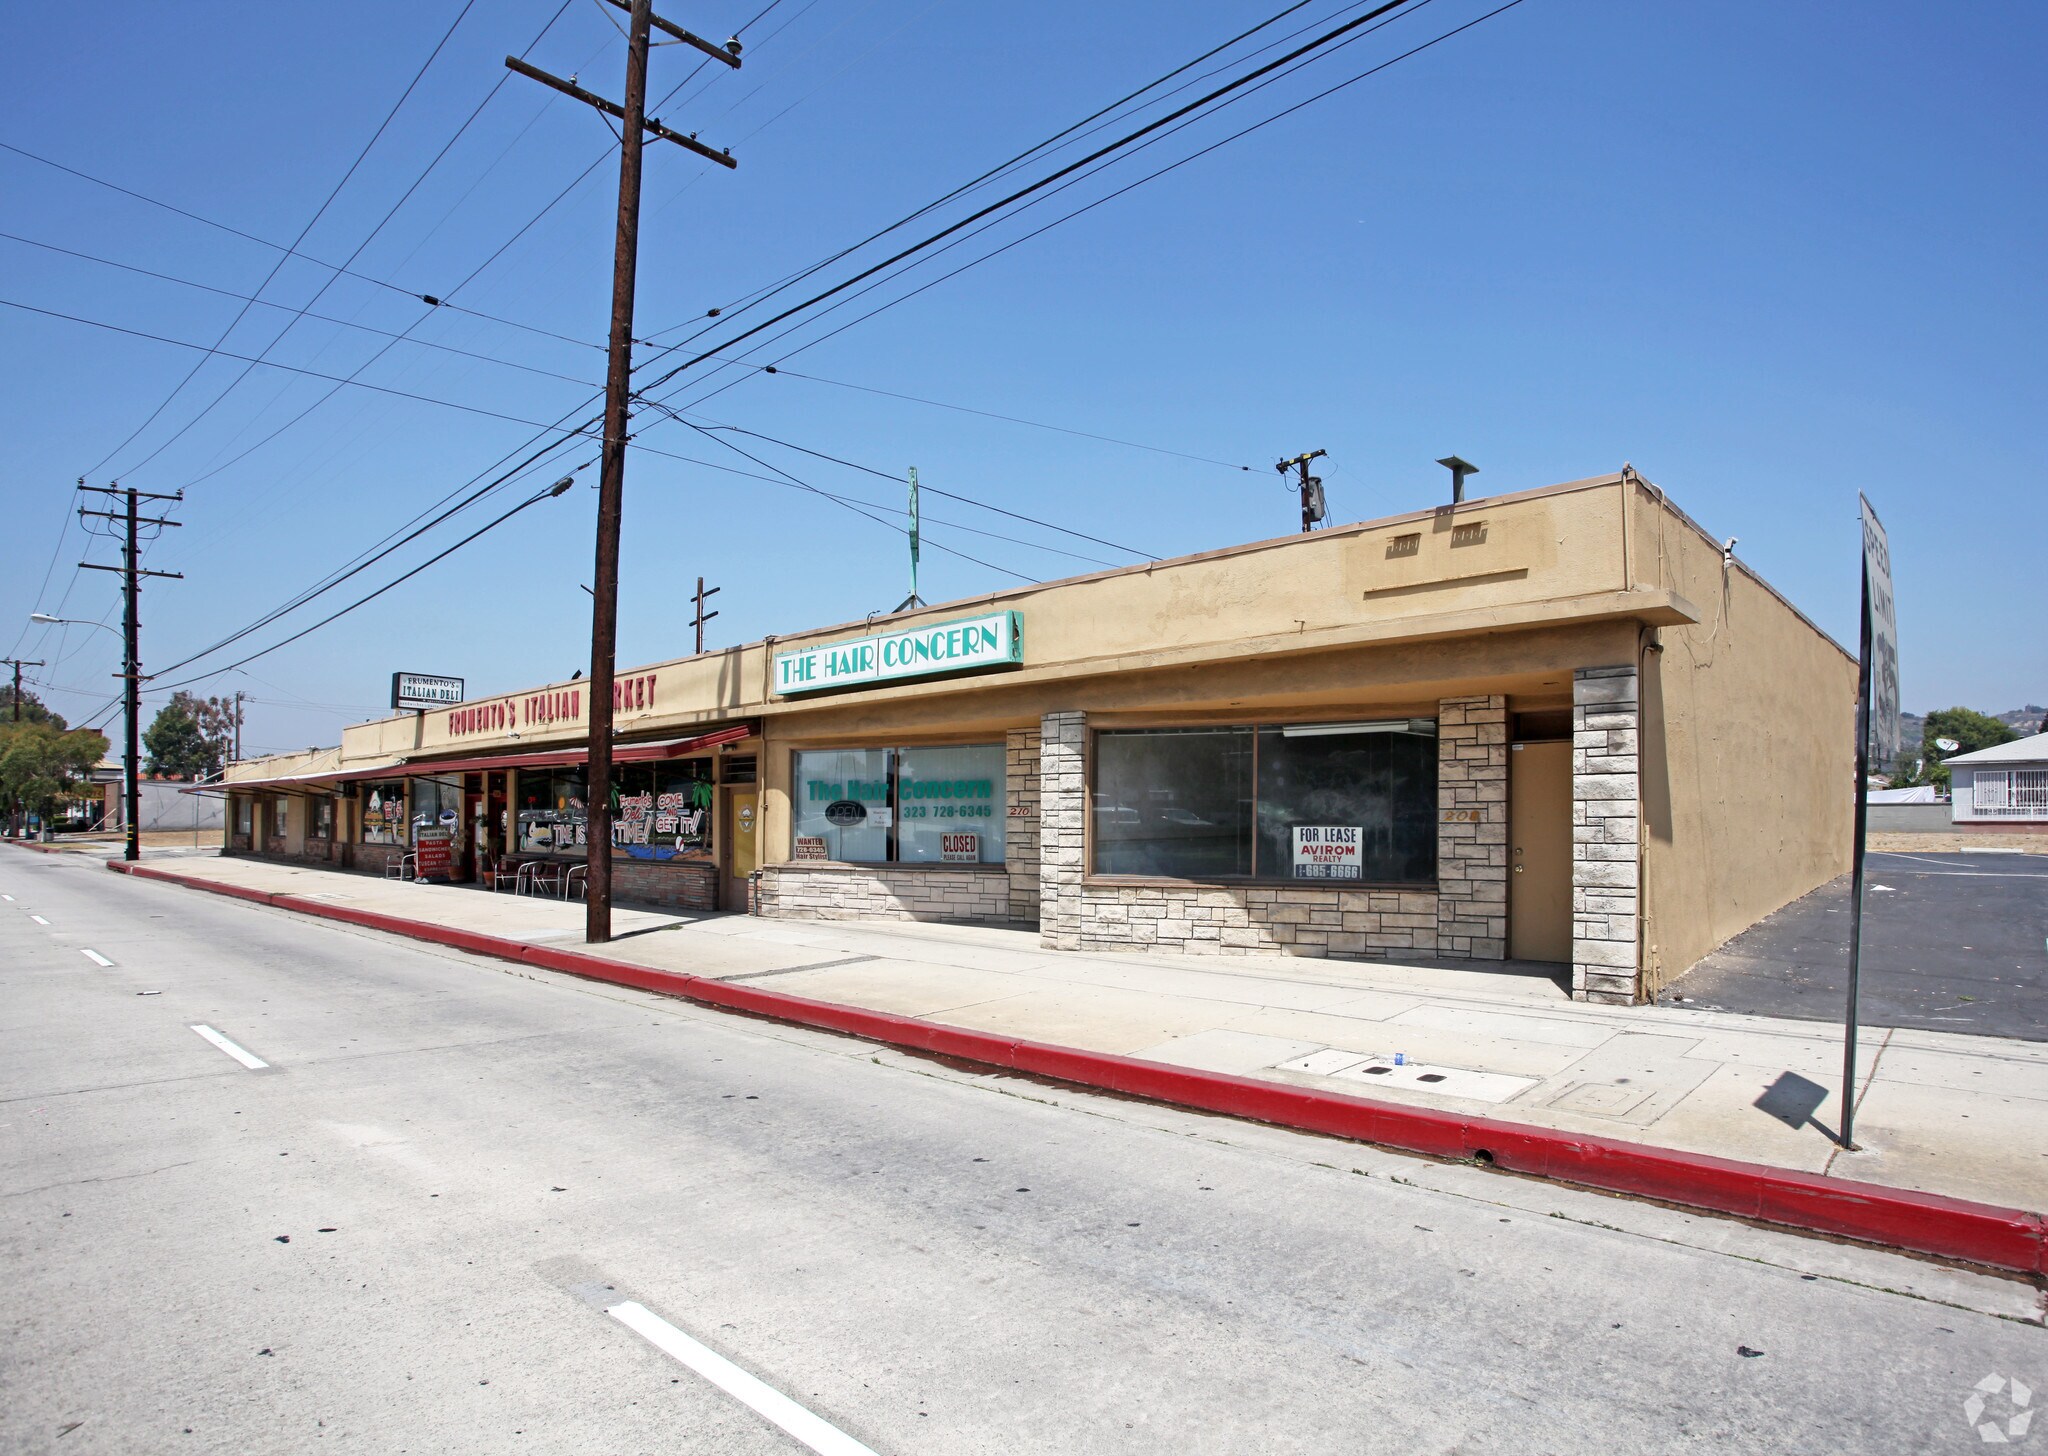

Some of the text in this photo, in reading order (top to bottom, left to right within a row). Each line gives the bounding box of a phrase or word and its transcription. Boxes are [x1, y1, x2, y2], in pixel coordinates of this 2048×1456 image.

[1865, 519, 1889, 579] SPEED
[1872, 576, 1893, 628] LIMIT
[781, 622, 998, 684] THE HAIR CONCERN
[408, 677, 456, 688] FRUMENTO'S
[402, 686, 459, 701] ITALIAN DELI
[449, 675, 656, 736] FRUMENTO'S ITALIAN RKET
[807, 778, 992, 801] The Hair Concern
[658, 793, 684, 809] COME
[623, 807, 643, 822] Deli
[666, 808, 677, 816] AND
[828, 806, 860, 820] OPEN
[903, 805, 991, 818] 323 728-6345
[1010, 807, 1030, 816] 210
[656, 817, 679, 834] GET
[1300, 828, 1356, 843] FOR LEASE
[943, 835, 976, 852] CLOSED
[1301, 845, 1355, 855] AVIROM
[1313, 855, 1342, 863] REALTY
